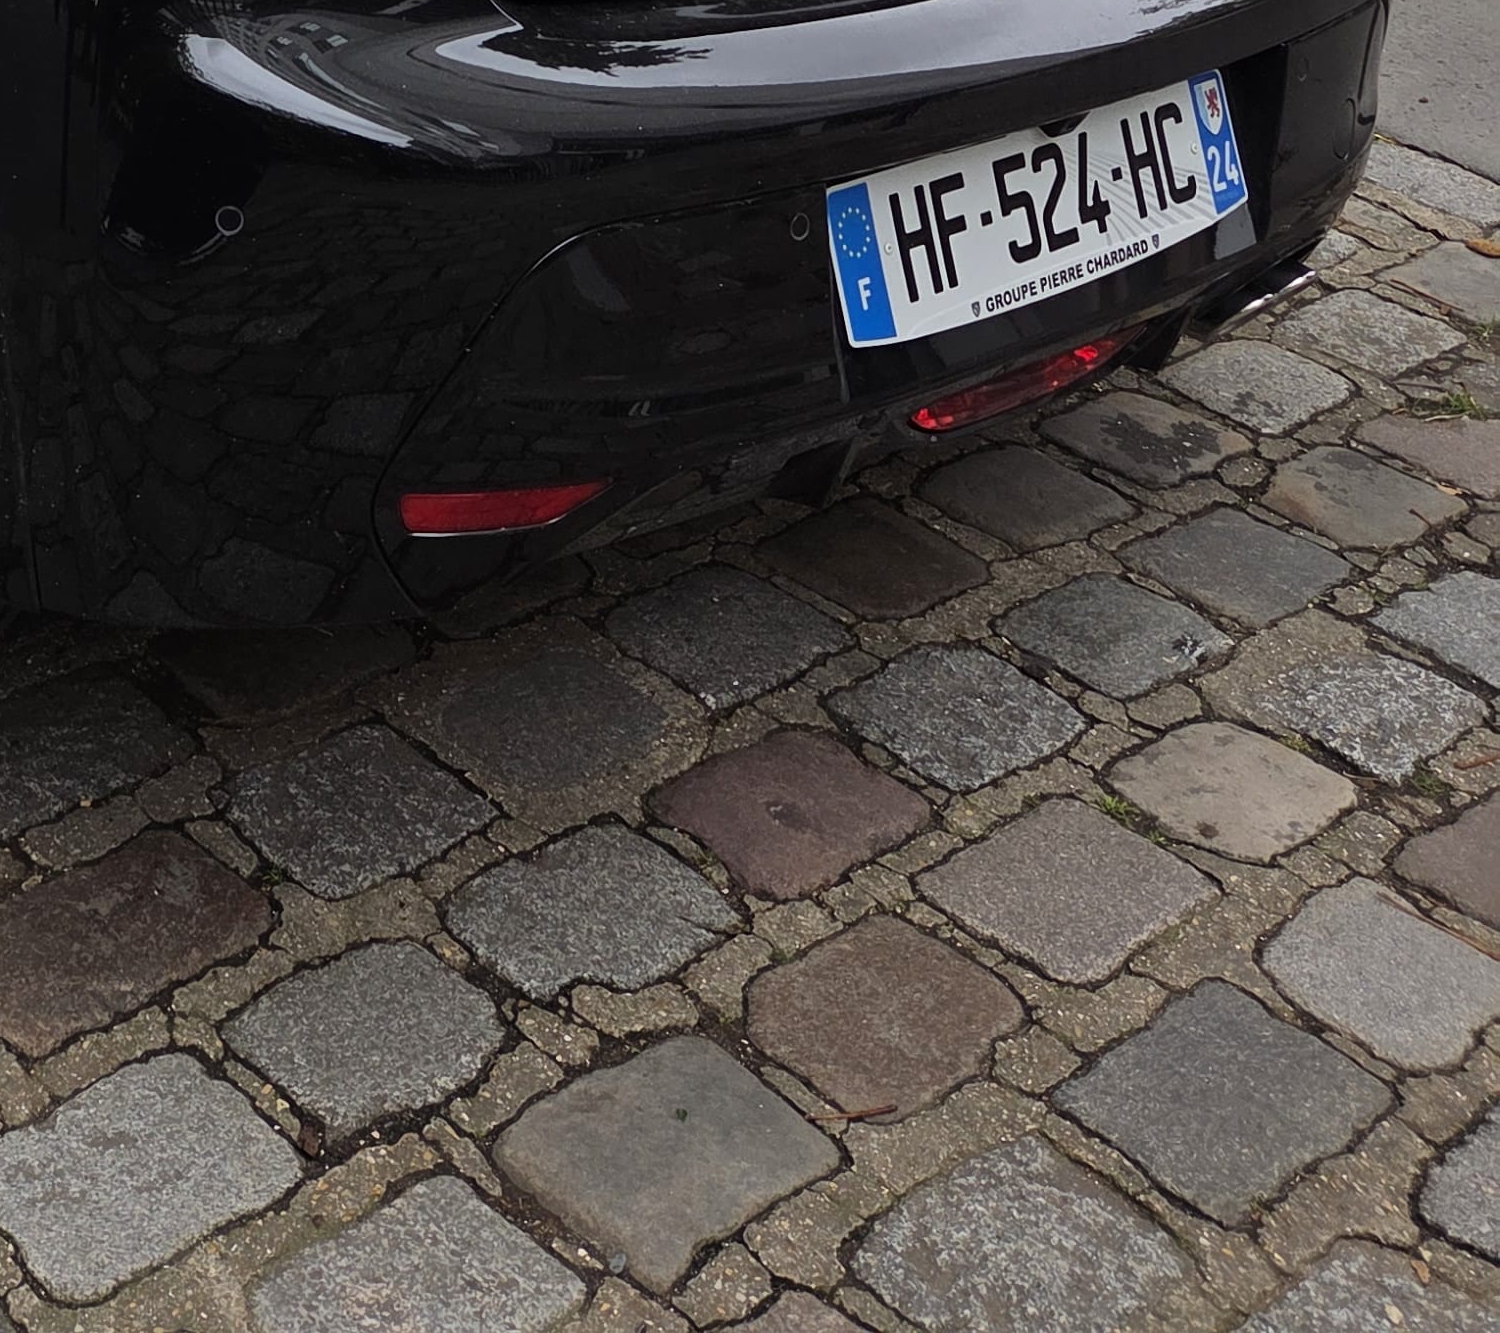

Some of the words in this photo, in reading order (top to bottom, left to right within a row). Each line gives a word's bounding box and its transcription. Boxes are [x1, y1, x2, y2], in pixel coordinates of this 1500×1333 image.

[1206, 140, 1240, 193] 24
[889, 101, 1198, 304] HF-524-HC
[857, 276, 872, 312] F
[985, 281, 1038, 313] GROUPE
[1040, 263, 1085, 293] PIERRE
[1086, 239, 1149, 275] CHARDARD
